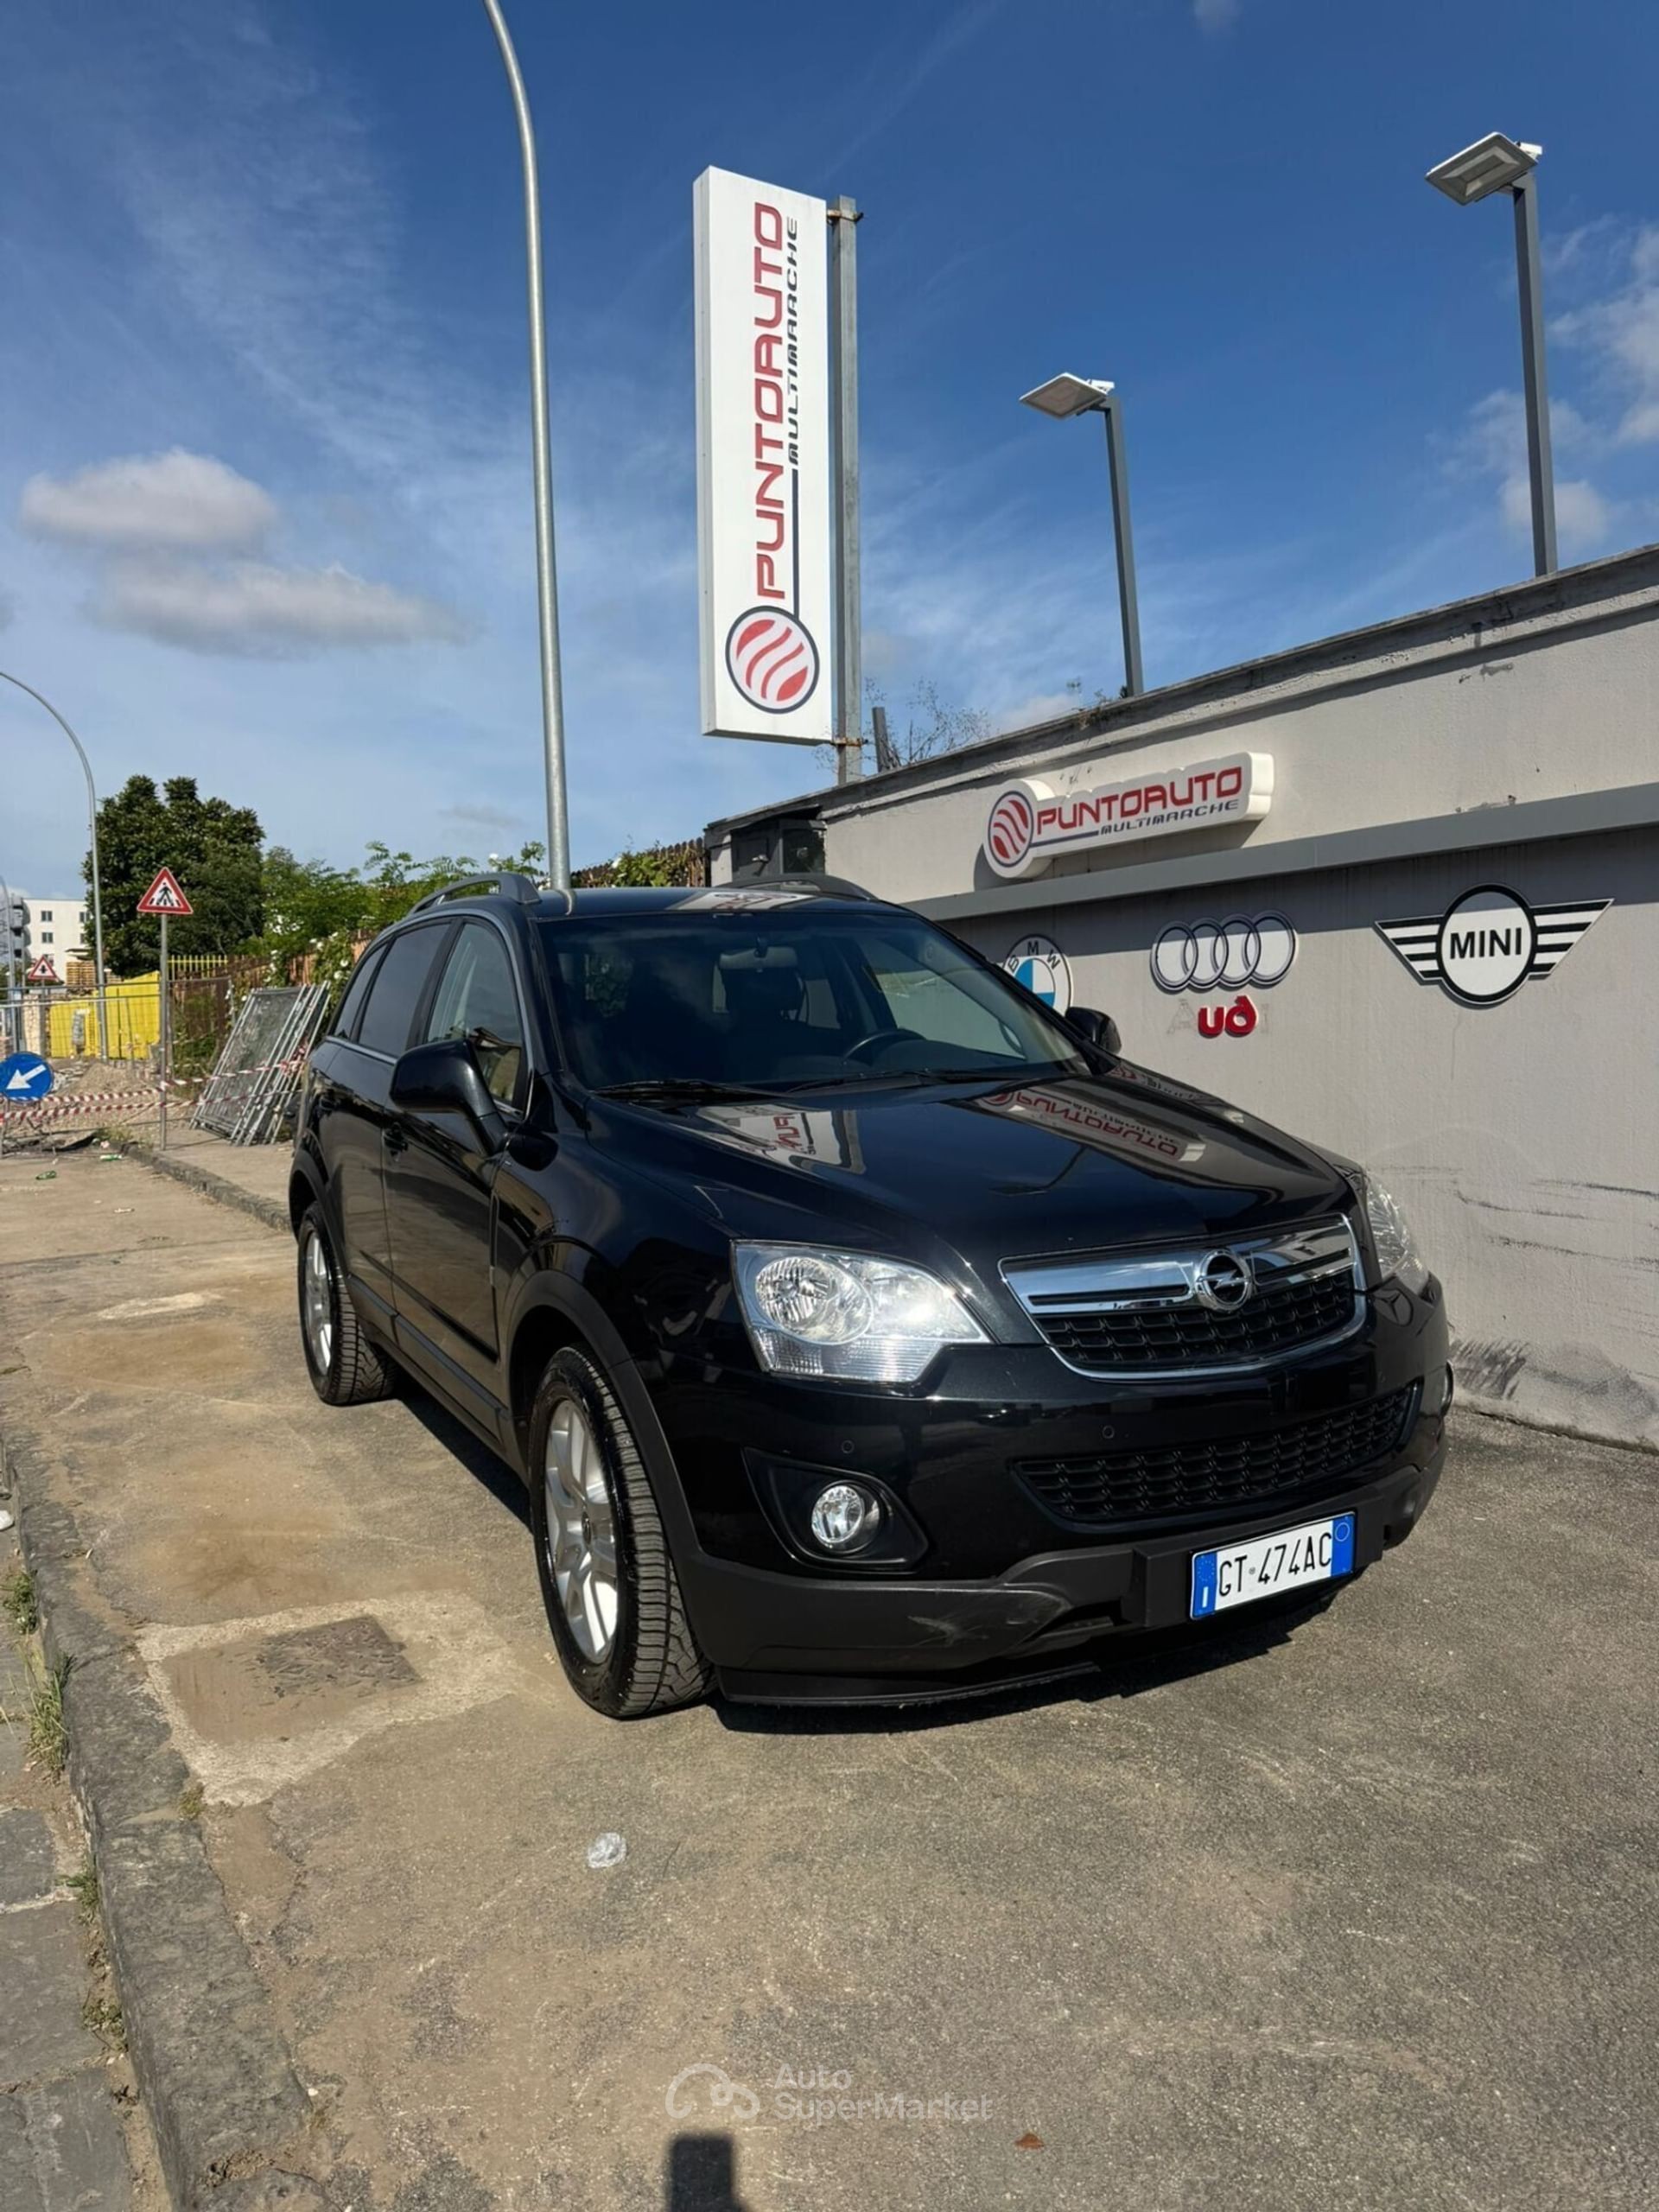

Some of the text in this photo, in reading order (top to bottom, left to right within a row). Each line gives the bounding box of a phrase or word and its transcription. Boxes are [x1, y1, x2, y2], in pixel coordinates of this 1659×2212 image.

[786, 216, 799, 467] MULTIMARCHE
[754, 201, 785, 600] PUNTOAUTO
[1037, 766, 1243, 836] PUNTOAUTO
[1100, 798, 1240, 836] MULTIMARCHE
[1007, 939, 1061, 974] BMW
[1450, 927, 1522, 960] MINI
